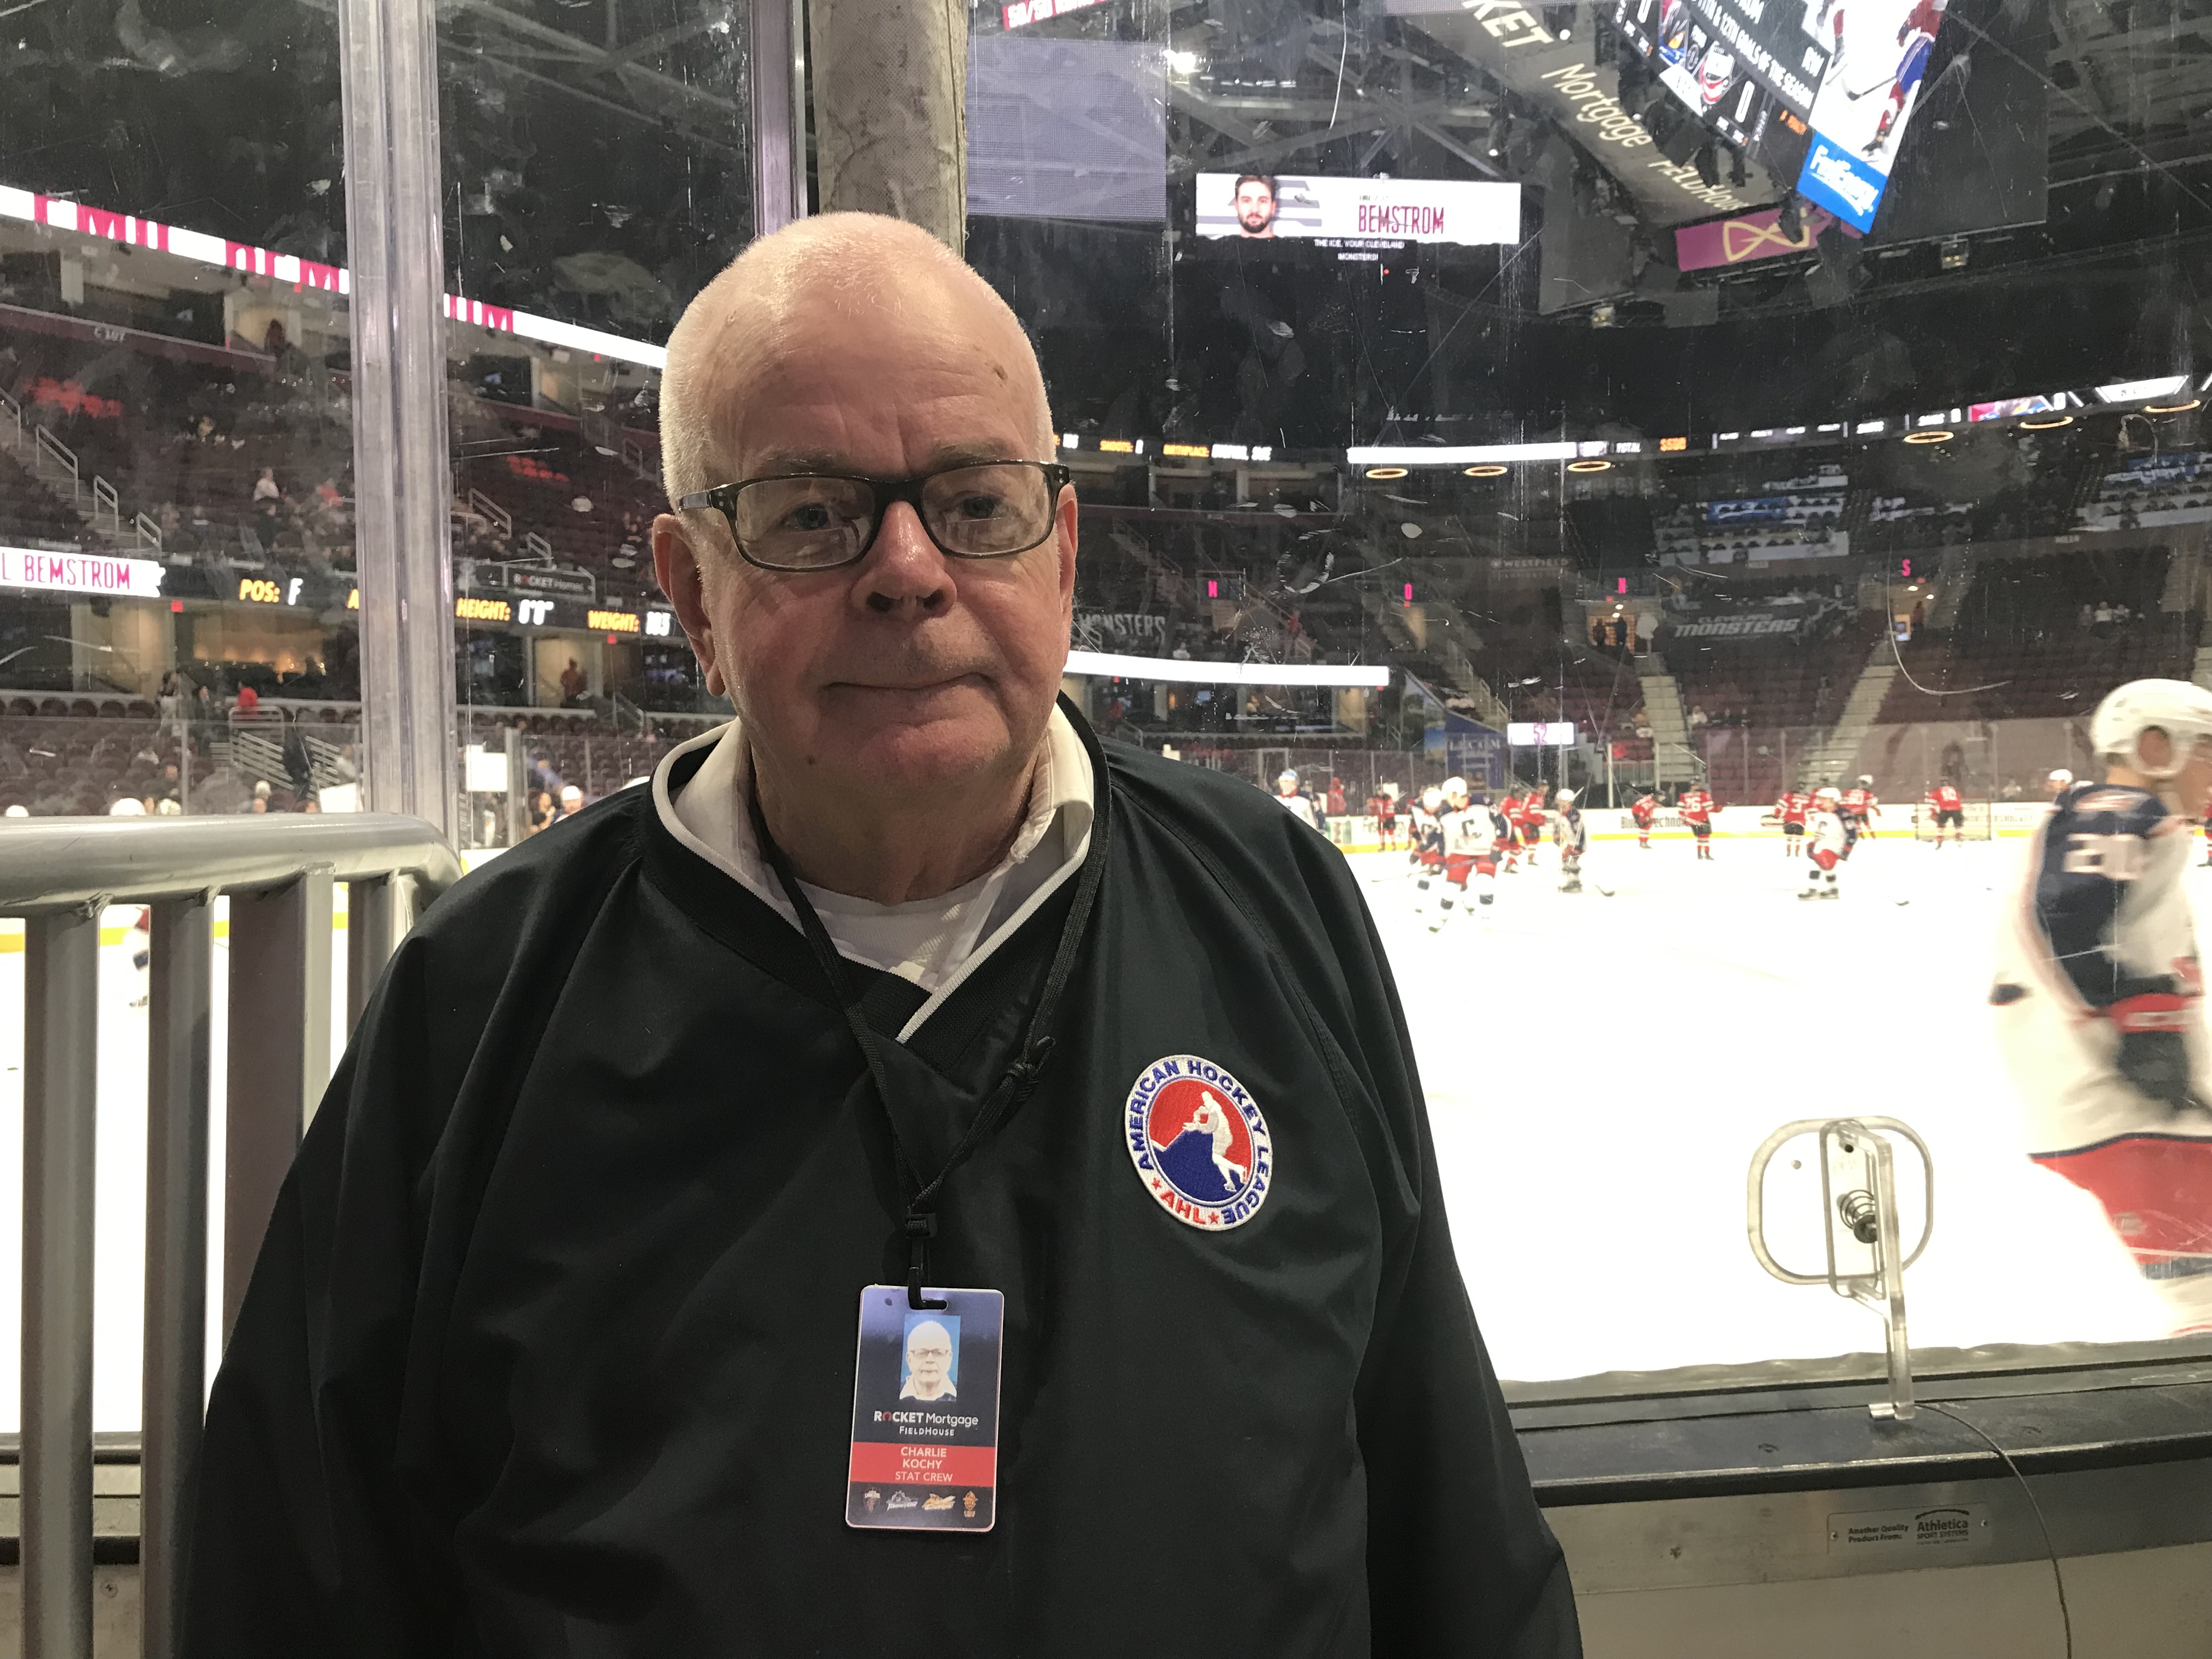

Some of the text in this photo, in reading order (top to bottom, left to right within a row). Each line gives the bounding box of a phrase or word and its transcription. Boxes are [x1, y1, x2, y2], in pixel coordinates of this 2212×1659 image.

[1541, 63, 1654, 147] Mortgage
[1358, 205, 1444, 234] BEMSTROM
[24, 554, 130, 590] BEMSTROM
[514, 573, 553, 588] ROCKET
[239, 578, 304, 606] POS: F
[456, 597, 511, 622] HEIGHT:
[588, 610, 640, 633] WEIGHT:
[1129, 1059, 1268, 1224] AMERICAN HOCKEY LEAGUE
[1160, 1190, 1206, 1224] AHL
[874, 1410, 979, 1427] ROCKET Mortgage
[900, 1446, 947, 1458] CHARLIE
[902, 1458, 943, 1469] KOCHY
[895, 1471, 953, 1482] STAT CREW
[1848, 1523, 1909, 1534] Another Quality
[1917, 1519, 1968, 1532] Athletica
[1917, 1531, 1937, 1539] SPORT
